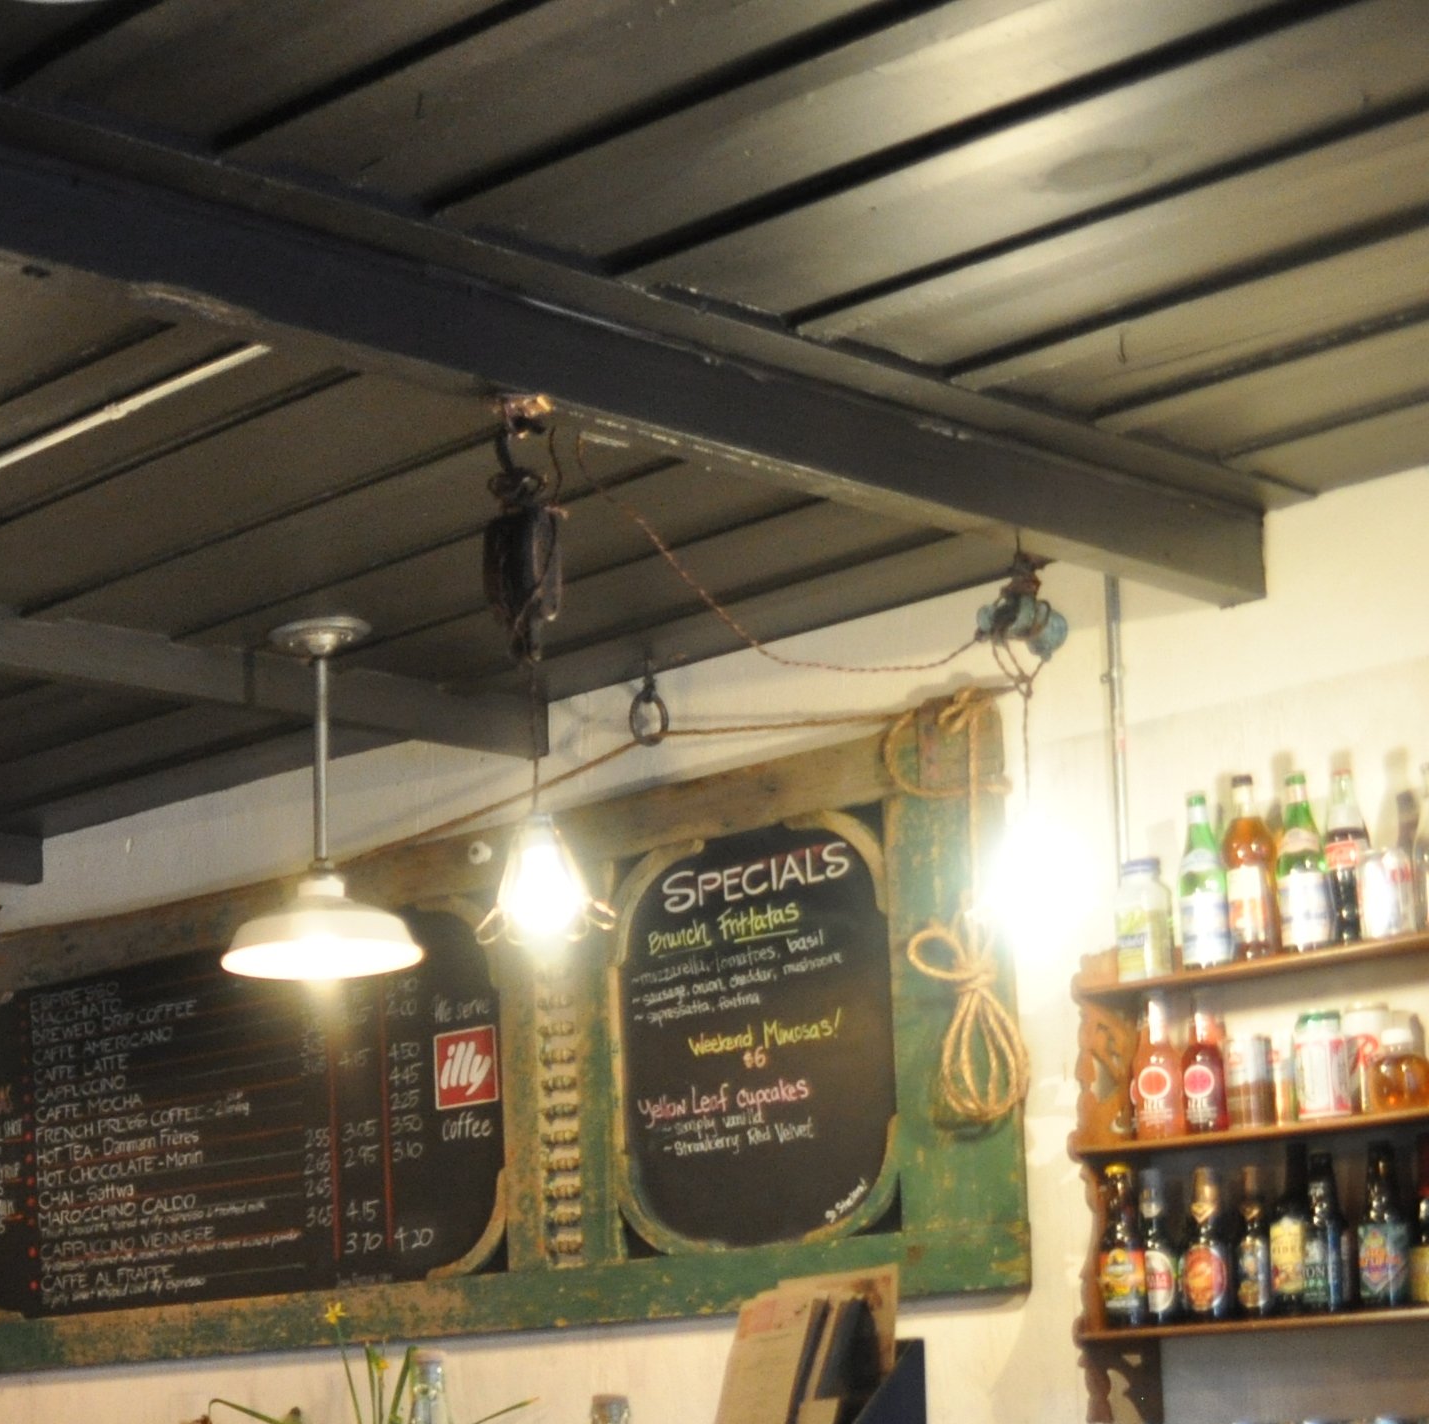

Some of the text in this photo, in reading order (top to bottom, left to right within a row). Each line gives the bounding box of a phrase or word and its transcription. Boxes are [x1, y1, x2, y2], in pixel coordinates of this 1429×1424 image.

[661, 841, 851, 914] SPECIALS
[647, 919, 713, 957] Brunch
[787, 928, 826, 955] basil
[136, 999, 198, 1025] COFFEE
[82, 1026, 174, 1056] AMERICANO
[83, 1053, 131, 1077] LATTE
[440, 1041, 492, 1097] illy
[87, 1092, 144, 1115] MOCHA
[690, 1081, 732, 1115] Leaf
[35, 1121, 95, 1145] FRENCH
[441, 1112, 494, 1142] coffee
[36, 1143, 63, 1166] HOT
[67, 1142, 94, 1163] TEA
[36, 1165, 64, 1188] HOT
[68, 1156, 158, 1184] CHOCOLATE
[37, 1190, 75, 1211] CHAI
[141, 1193, 197, 1216] CALDO
